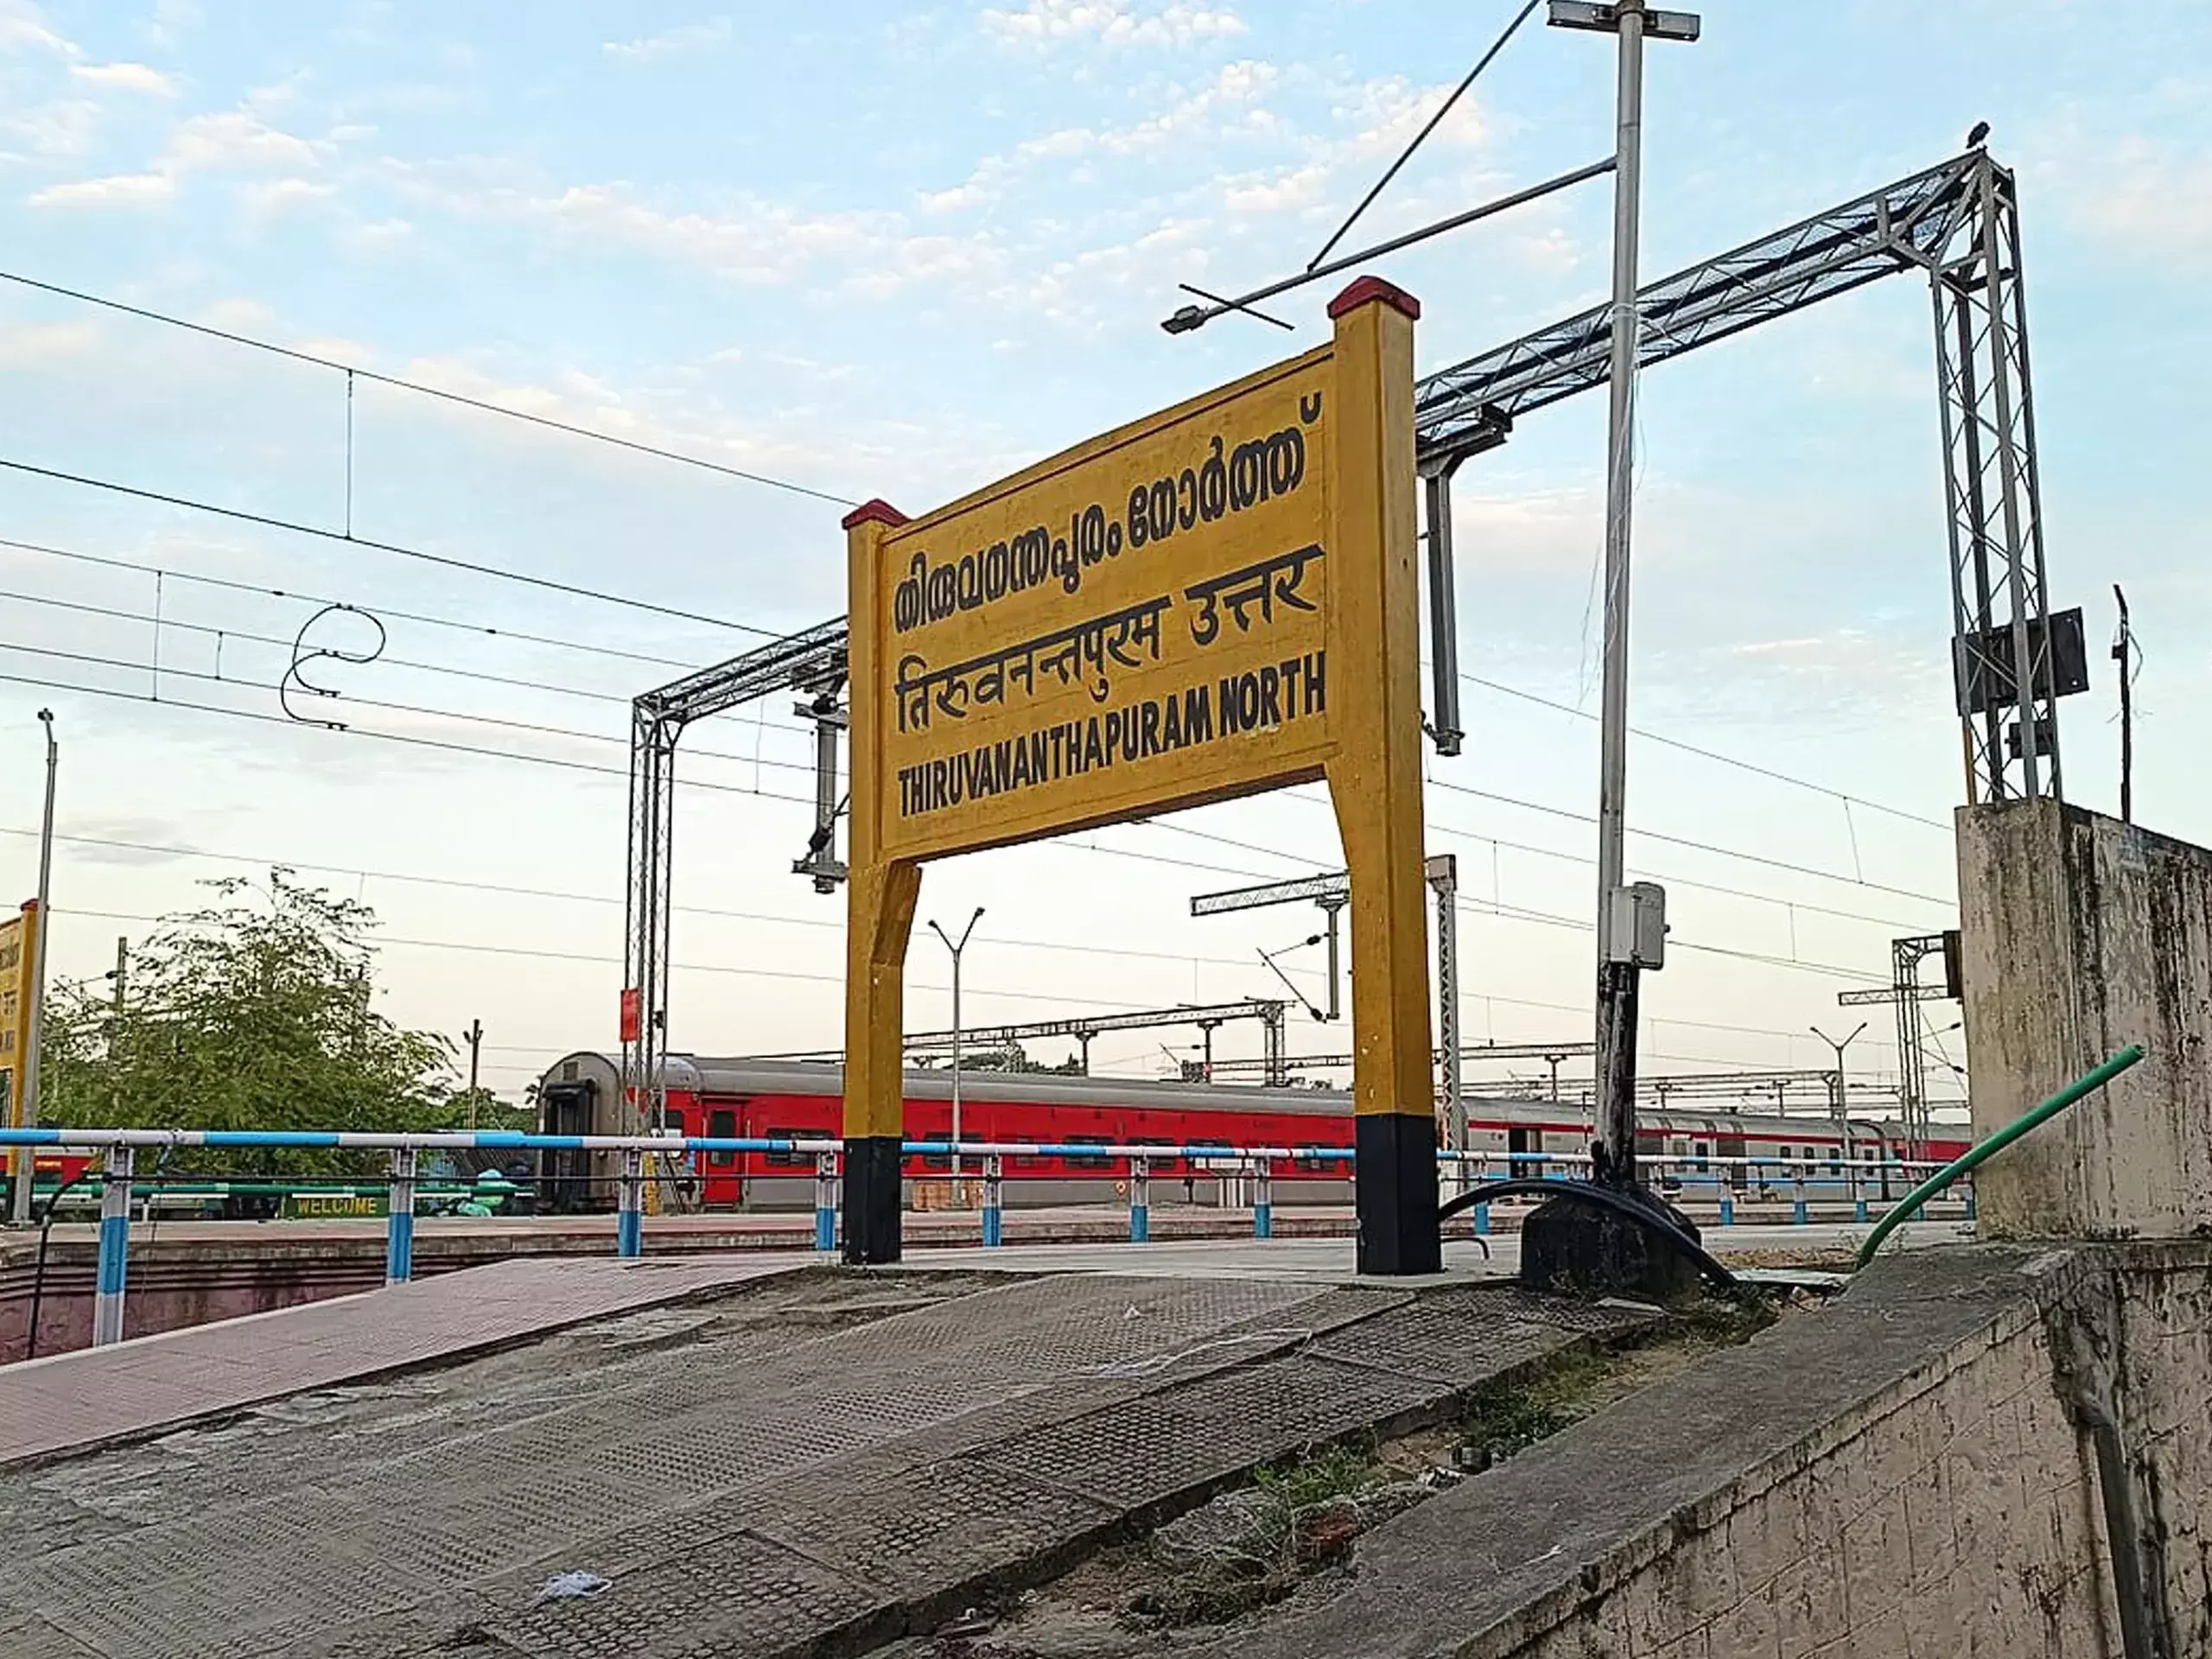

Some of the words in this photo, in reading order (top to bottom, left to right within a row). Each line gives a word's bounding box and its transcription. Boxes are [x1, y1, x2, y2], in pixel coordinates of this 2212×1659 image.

[894, 504, 1123, 633] തിരുവനന്തപുരം
[1128, 391, 1322, 548] നോർത്ത്
[1184, 543, 1326, 645] उत्तर
[898, 684, 1214, 817] THIRUVANANTHAPURAM
[1219, 650, 1326, 738] NORTH
[297, 1198, 378, 1214] WELCOME
